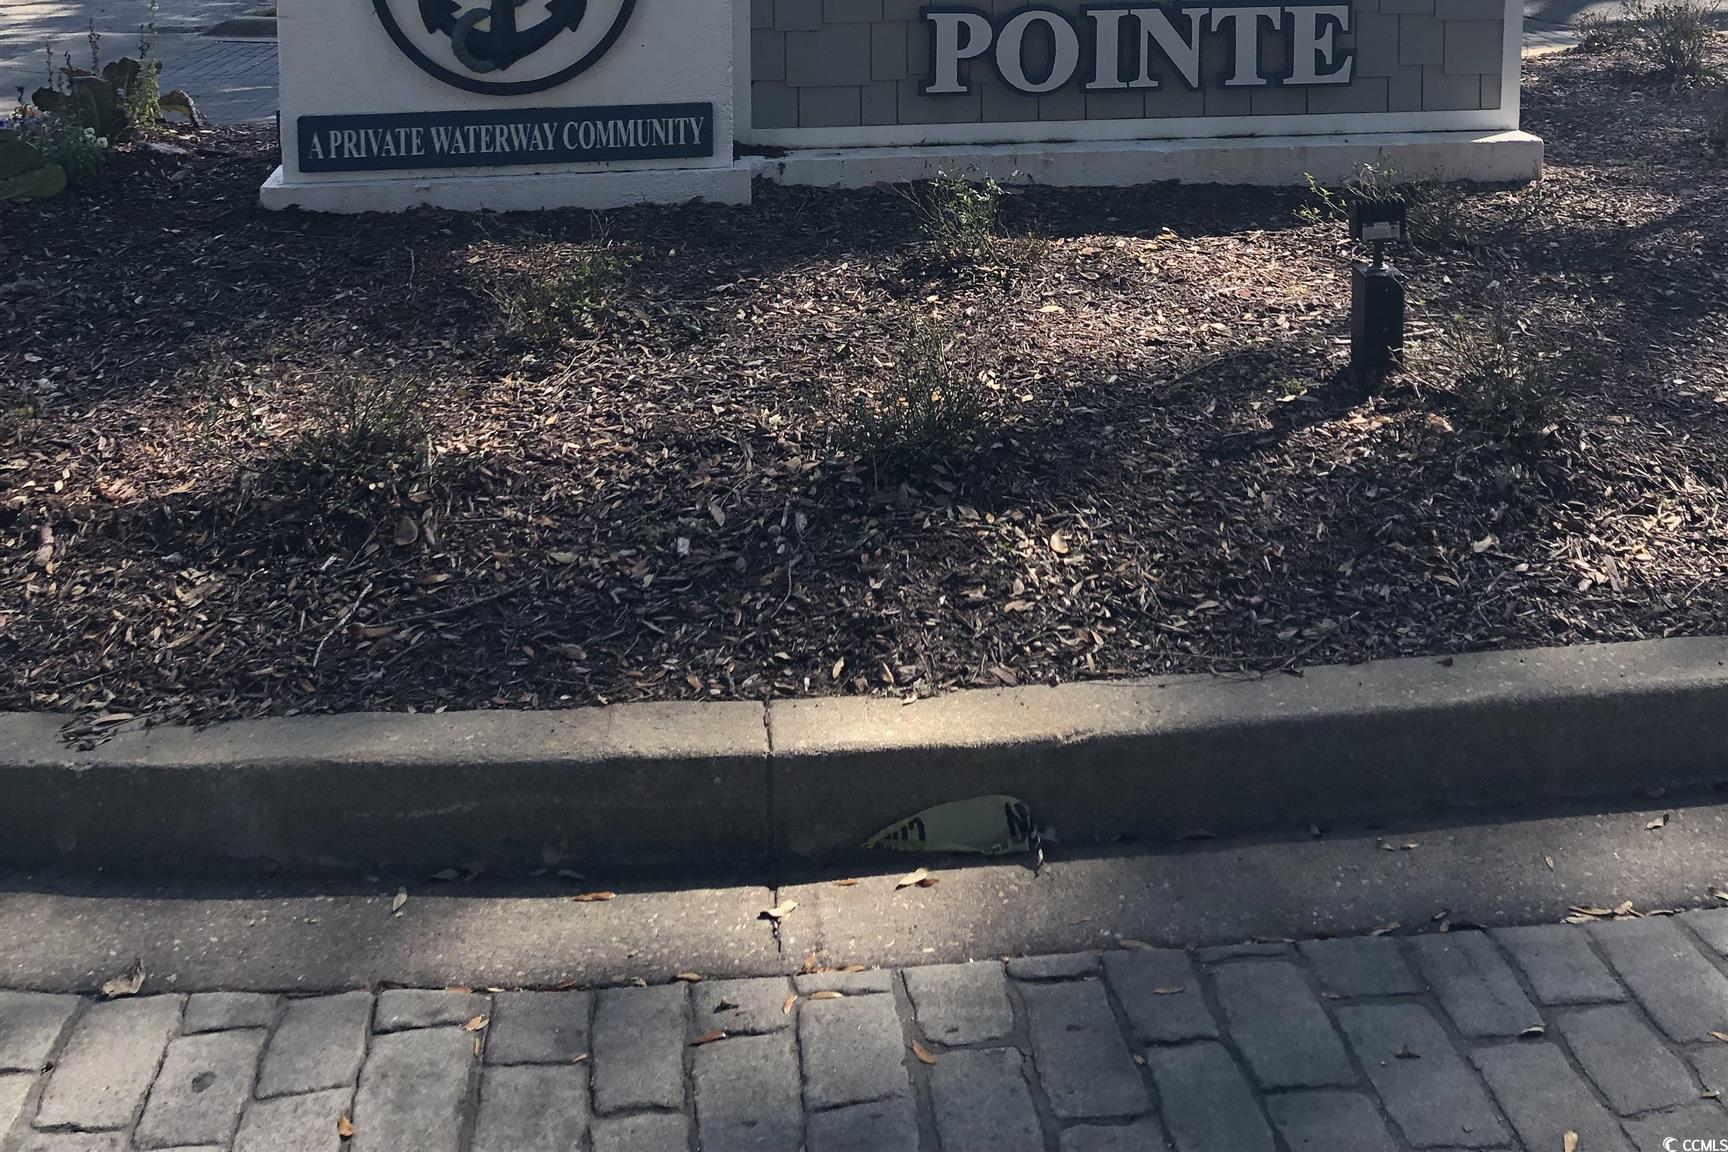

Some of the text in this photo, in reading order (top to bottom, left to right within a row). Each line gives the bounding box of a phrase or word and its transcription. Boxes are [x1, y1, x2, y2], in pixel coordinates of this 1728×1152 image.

[924, 4, 1353, 94] POINTE
[308, 117, 704, 159] A PRIVATE WATERWAY COMMUNITY
